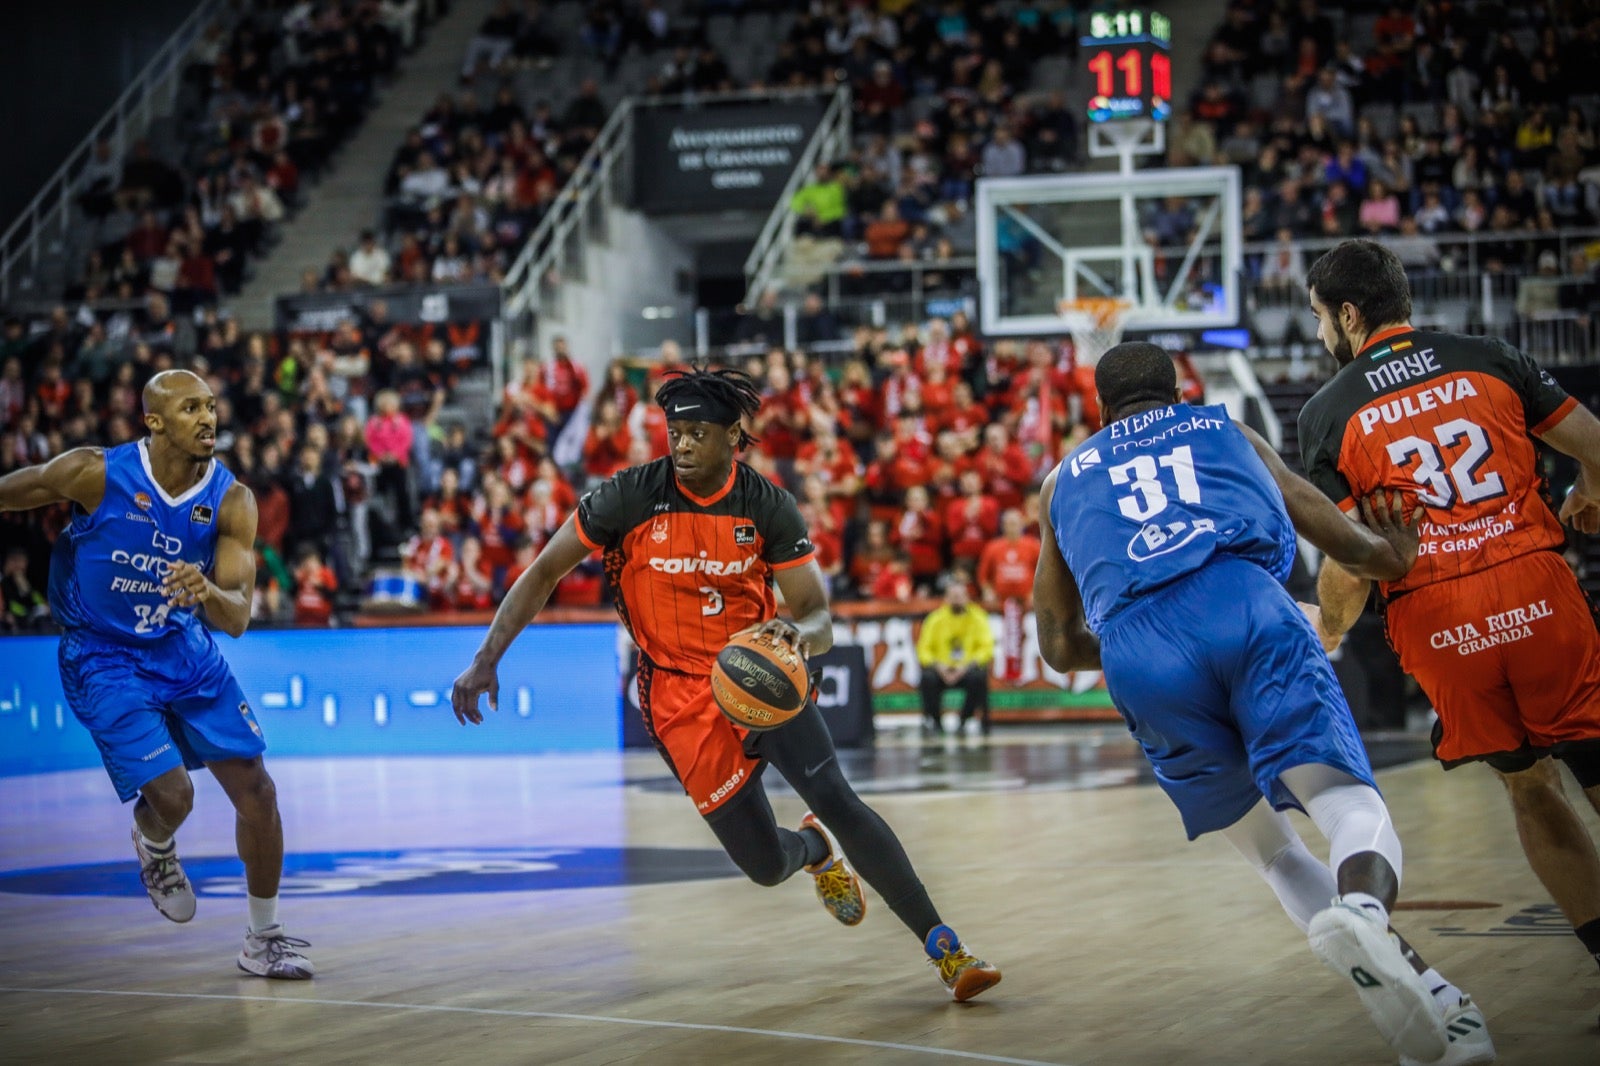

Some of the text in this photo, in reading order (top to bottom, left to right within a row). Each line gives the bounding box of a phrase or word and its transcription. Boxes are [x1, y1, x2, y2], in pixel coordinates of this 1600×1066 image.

[1088, 49, 1142, 97] 11
[1364, 348, 1441, 392] MAYE
[1358, 377, 1478, 436] PULEVA
[1108, 445, 1201, 522] 31
[1385, 417, 1508, 510] 32
[133, 604, 171, 634] 24
[699, 586, 724, 617] 3
[1430, 600, 1553, 650] CAJA RURAL
[1457, 625, 1533, 656] GRANADA
[709, 773, 740, 803] asisa
